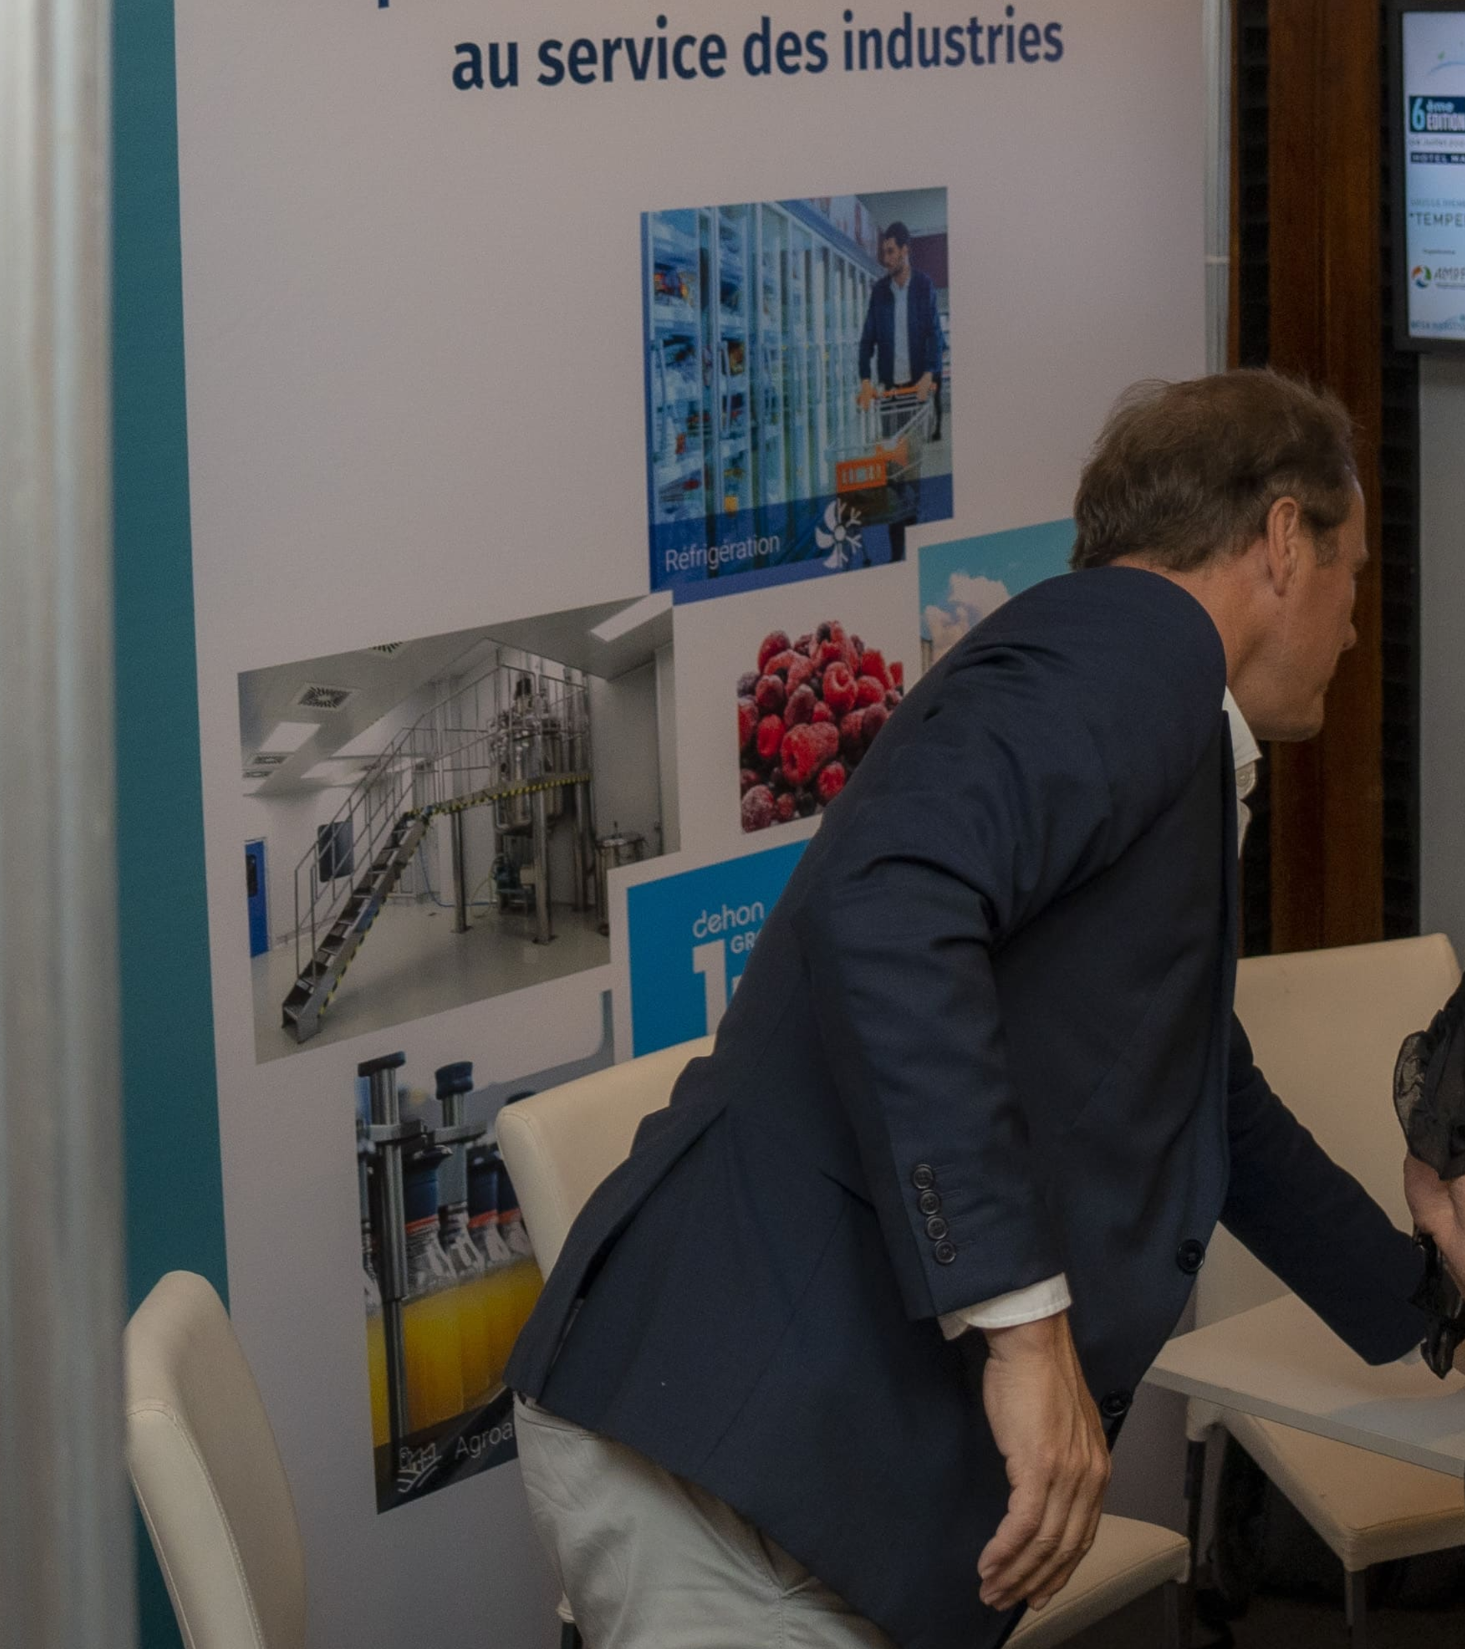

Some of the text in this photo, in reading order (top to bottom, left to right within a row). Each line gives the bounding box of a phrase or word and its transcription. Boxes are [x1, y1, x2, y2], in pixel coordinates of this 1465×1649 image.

[451, 4, 1065, 91] au service des industries
[664, 534, 781, 573] Réfrigération
[692, 900, 765, 938] dehon
